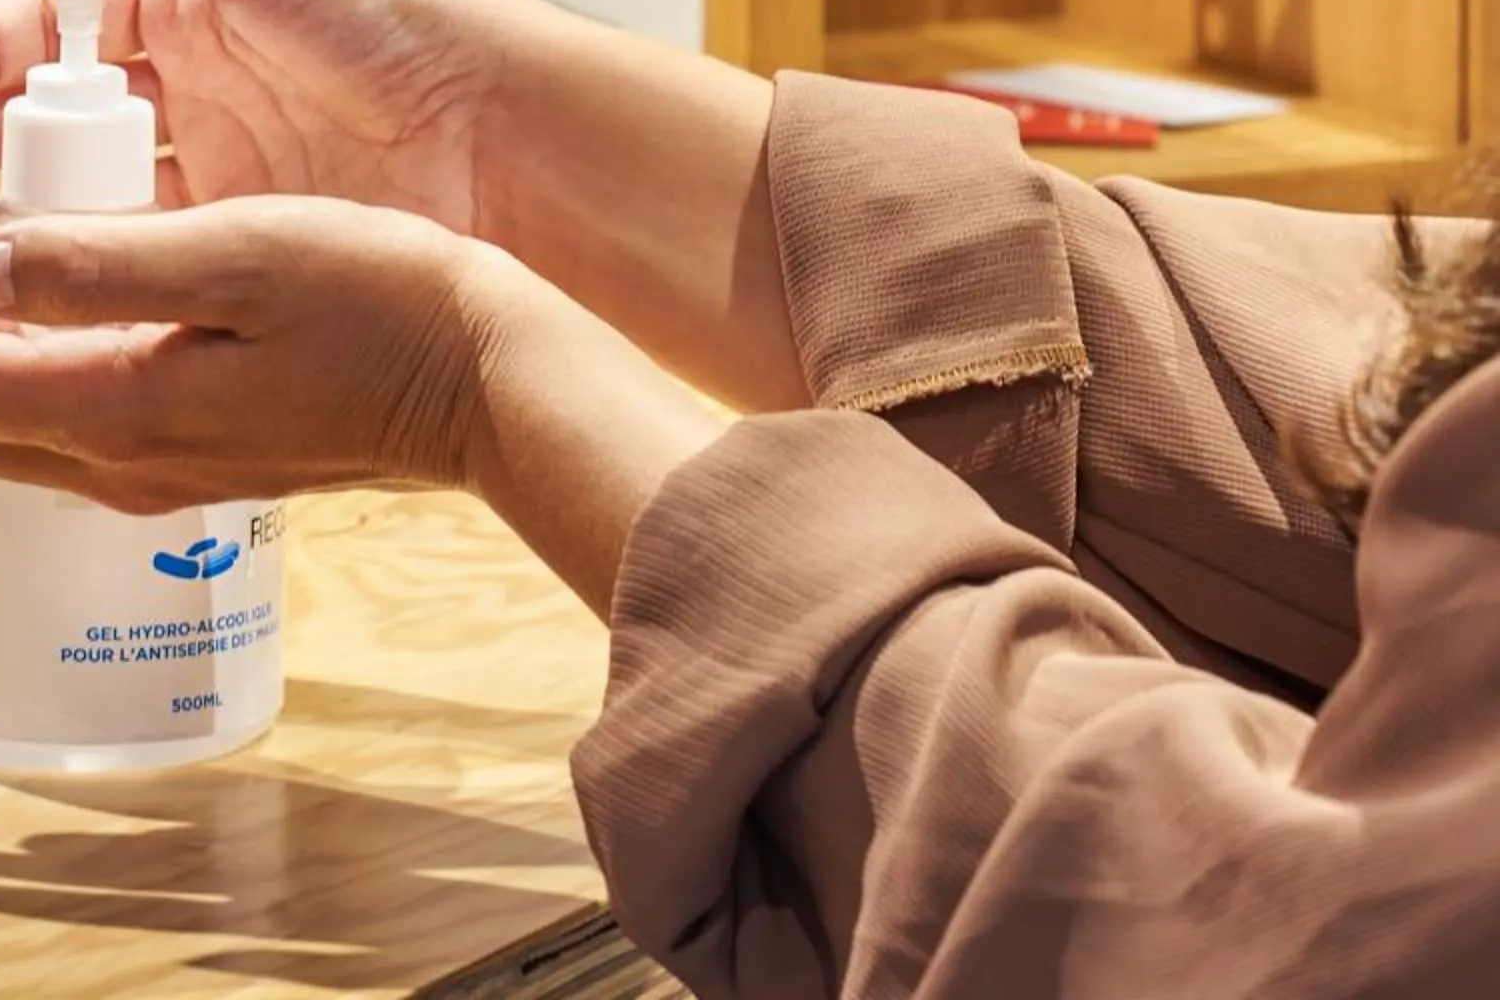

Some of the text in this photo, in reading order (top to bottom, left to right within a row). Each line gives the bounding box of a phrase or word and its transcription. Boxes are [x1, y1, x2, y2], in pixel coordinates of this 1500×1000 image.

[86, 626, 122, 643] GEL
[61, 648, 114, 664] POUR
[119, 637, 228, 663] L'ANTISEPSIE
[171, 692, 222, 714] 500ML
